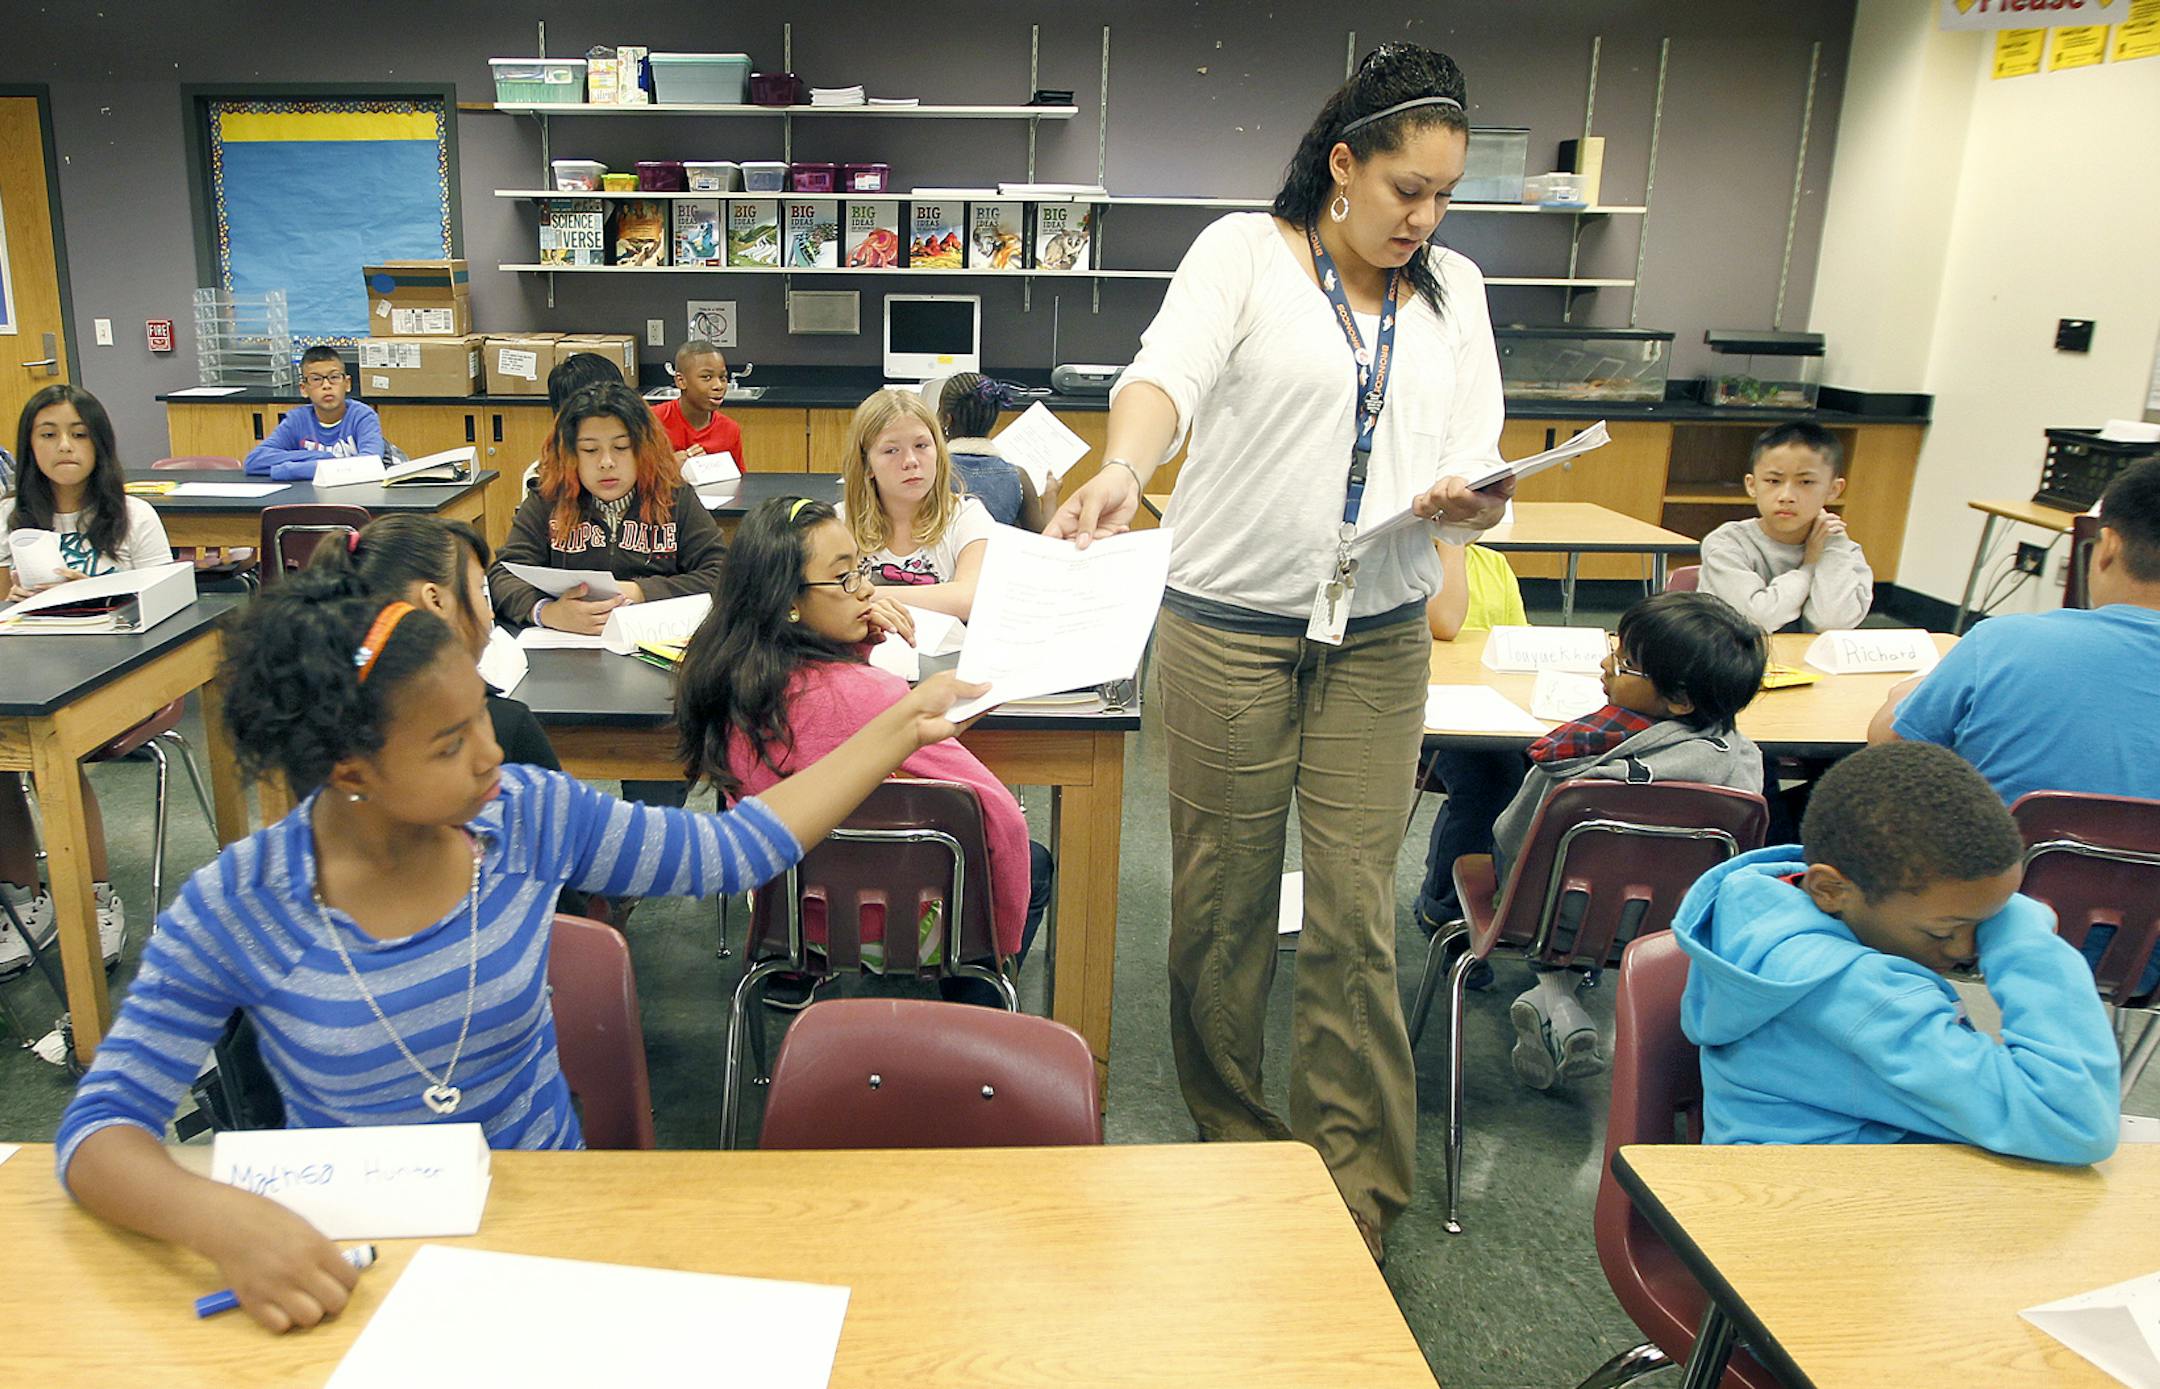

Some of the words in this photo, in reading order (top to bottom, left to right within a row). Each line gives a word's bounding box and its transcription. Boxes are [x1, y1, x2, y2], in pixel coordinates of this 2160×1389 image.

[678, 205, 698, 217] BIG
[734, 205, 757, 218] BIG
[791, 205, 815, 218] BIG
[851, 206, 876, 219] BIG
[916, 207, 941, 219] BIG
[976, 207, 1000, 220] BIG
[1043, 208, 1068, 220] BIG
[551, 214, 593, 229] SCIENCE
[791, 218, 814, 226] IDEAS
[563, 231, 602, 248] VERSE
[149, 323, 168, 337] FIRE
[618, 520, 678, 553] DALE
[1841, 637, 1917, 664] Richard
